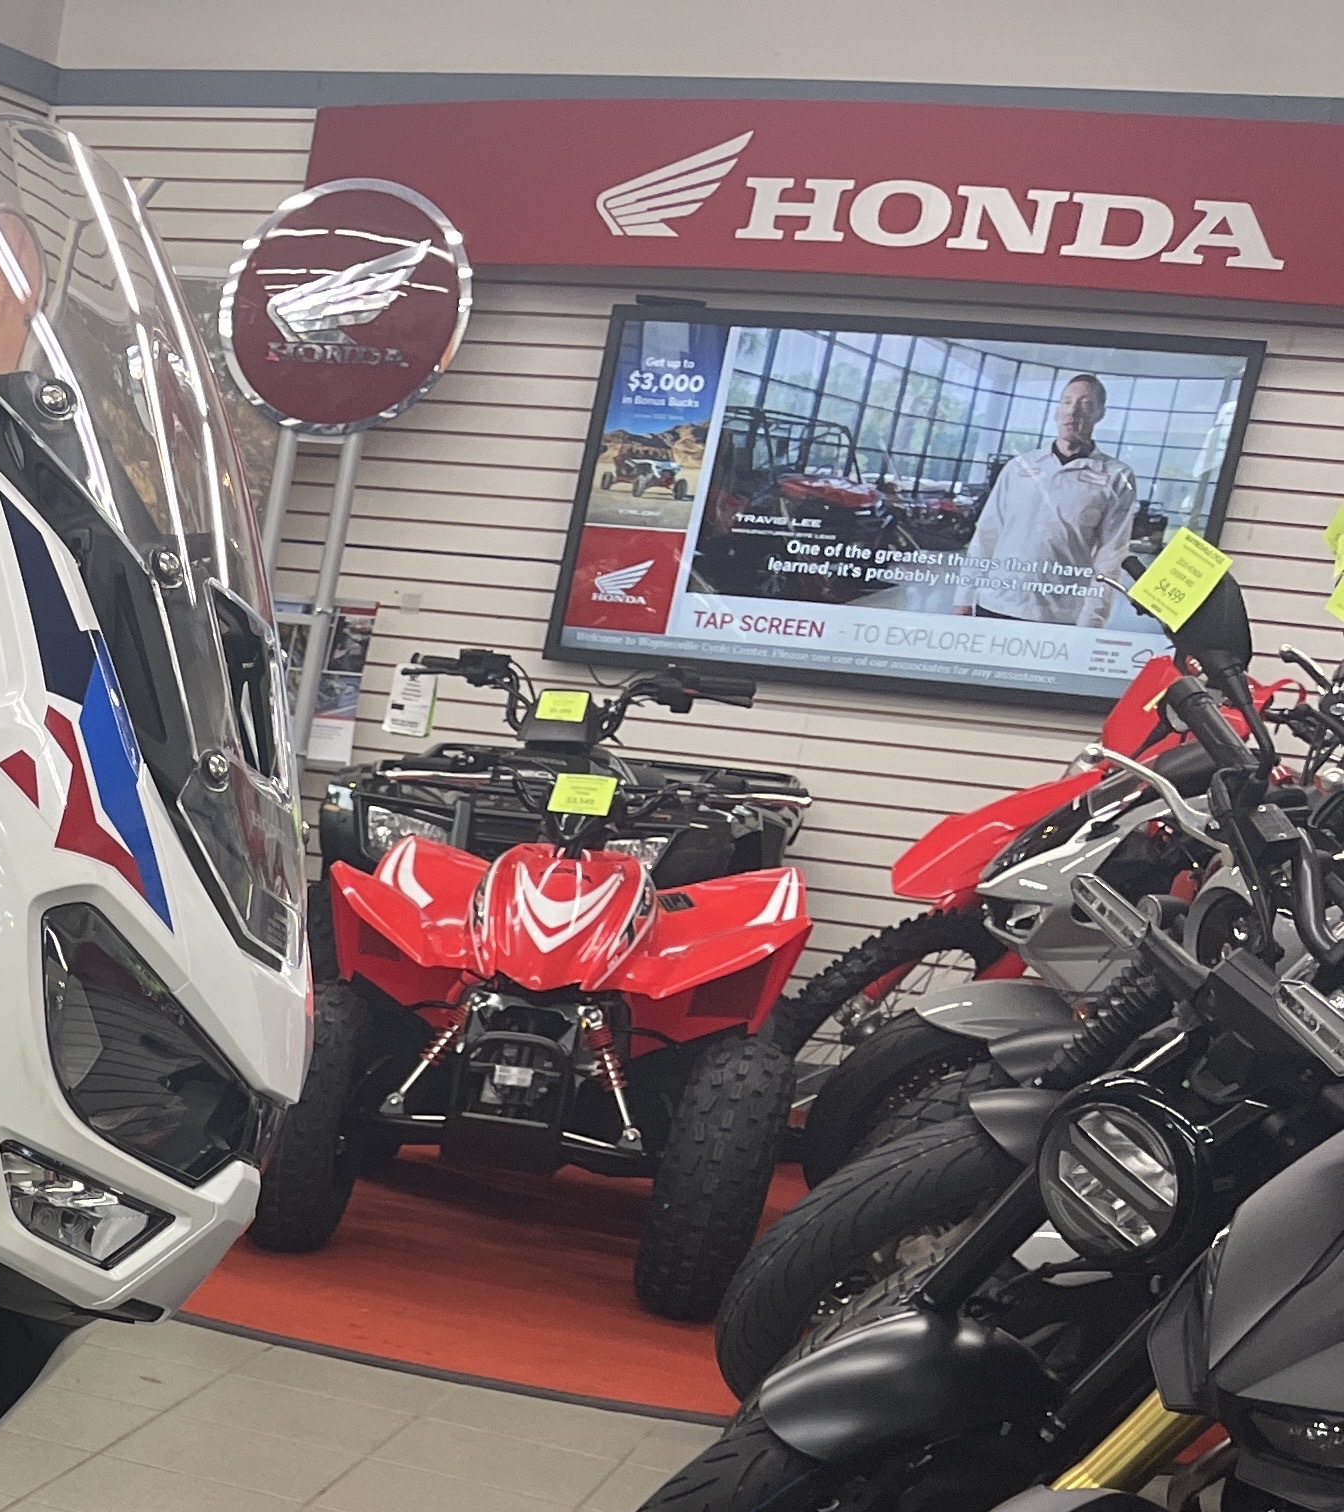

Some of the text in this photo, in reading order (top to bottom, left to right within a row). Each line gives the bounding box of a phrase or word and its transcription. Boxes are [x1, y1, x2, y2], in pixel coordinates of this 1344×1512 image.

[734, 175, 1285, 271] HONDA
[266, 340, 410, 369] HONDA
[628, 370, 705, 393] $3,000
[791, 517, 823, 529] LEE
[786, 539, 1094, 578] One of the greatest things that I have
[767, 556, 1105, 599] learned, it's probably the most important
[591, 592, 647, 605] HONDA
[693, 610, 735, 631] TAP
[739, 613, 826, 639] SCREEN
[852, 622, 882, 644] TO
[885, 625, 986, 655] EXPLORE
[989, 636, 1071, 662] HONDA
